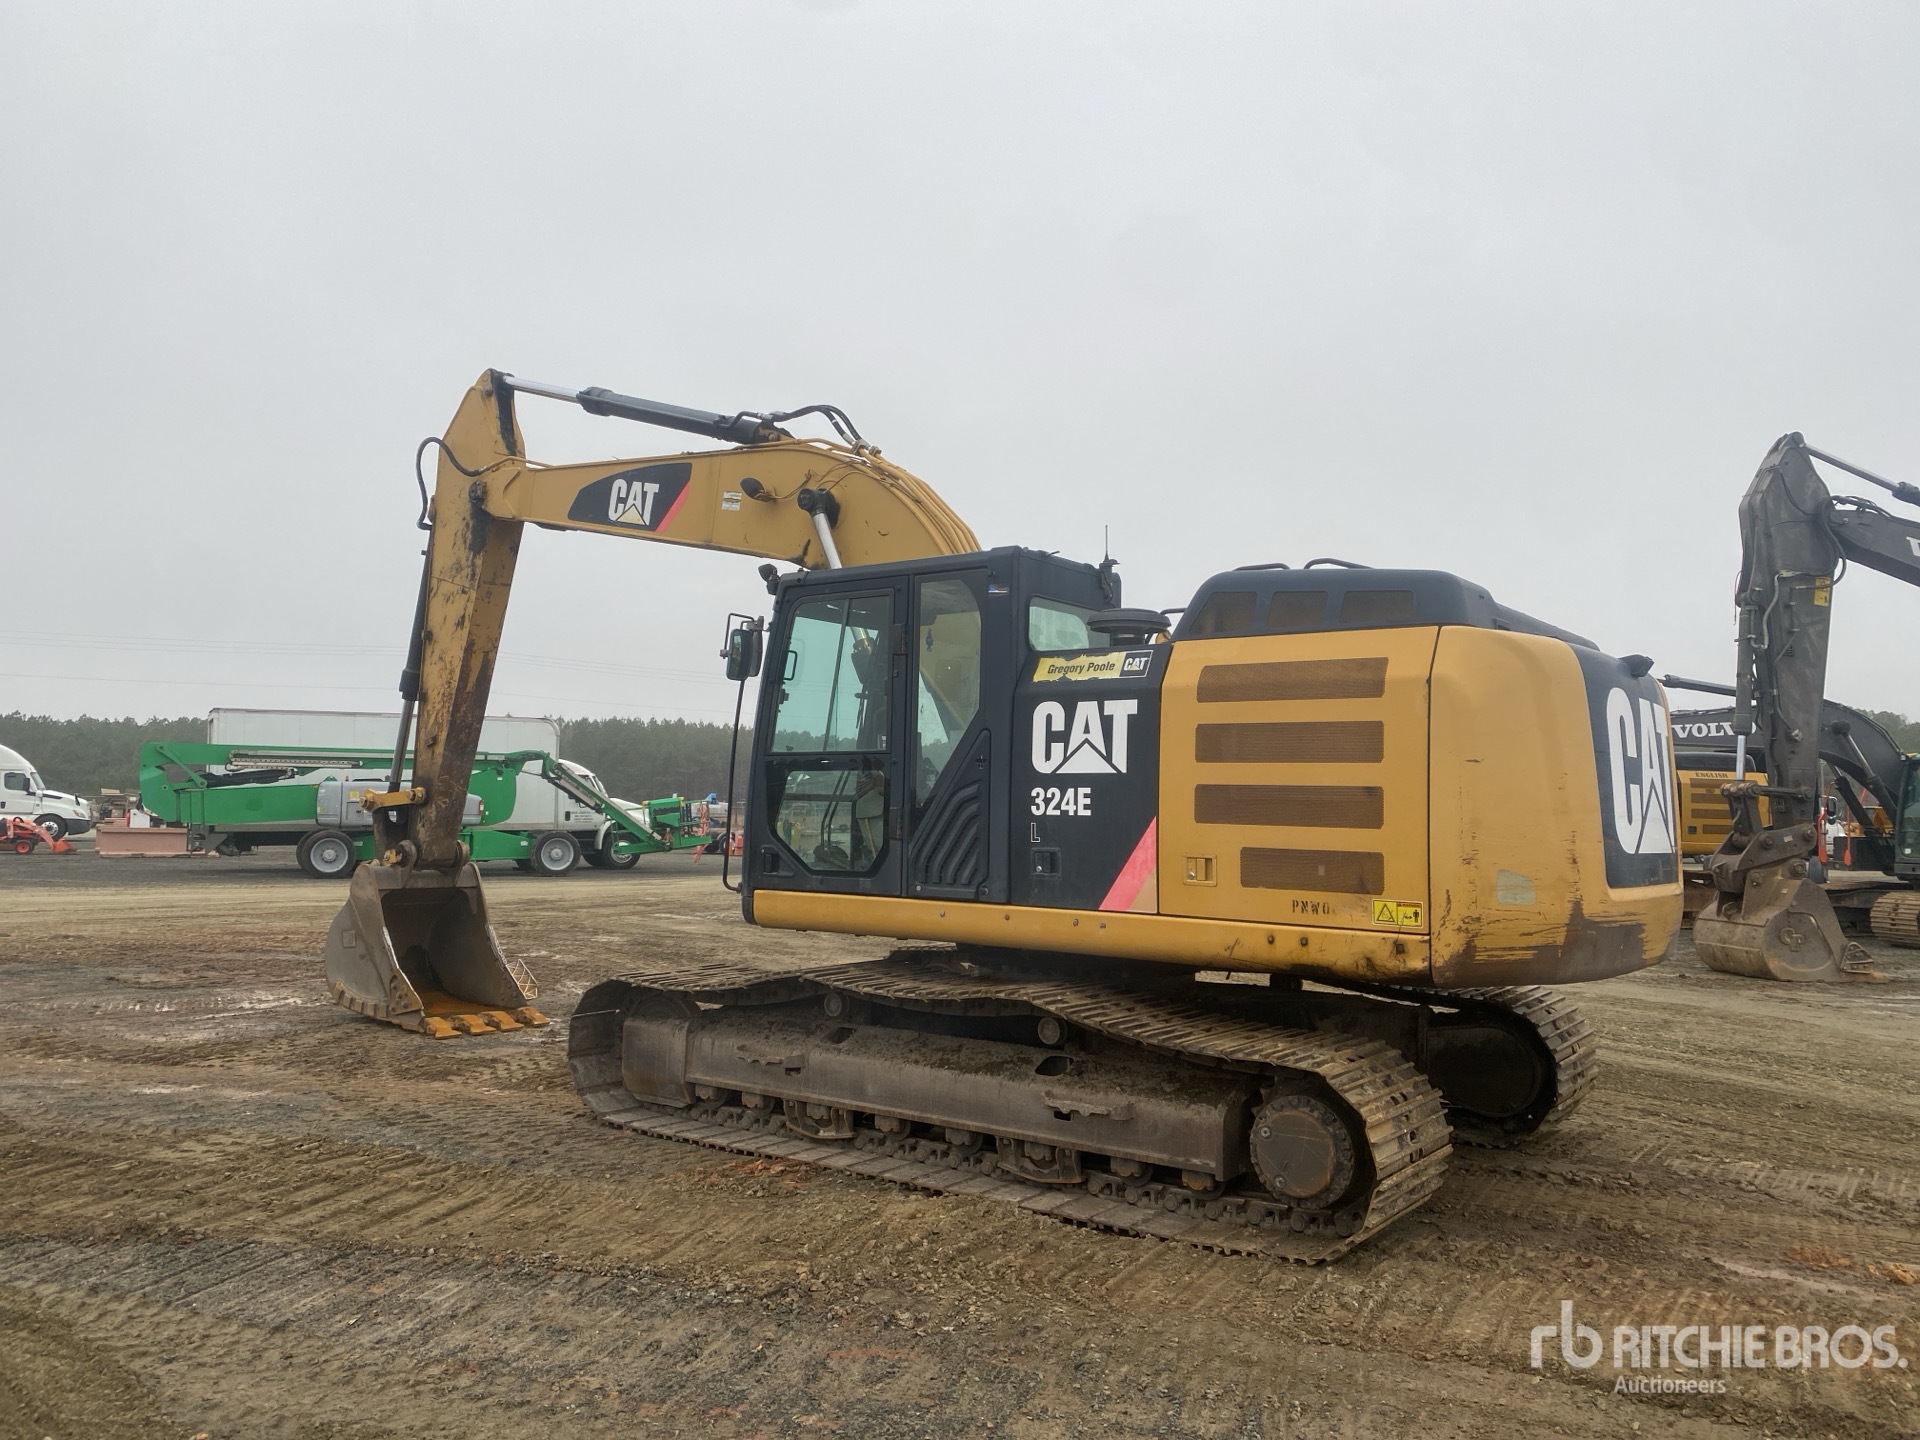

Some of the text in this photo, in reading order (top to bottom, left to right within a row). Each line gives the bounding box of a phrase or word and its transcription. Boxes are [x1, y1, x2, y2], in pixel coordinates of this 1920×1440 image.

[608, 478, 660, 526] CAT
[1047, 657, 1148, 677] Gregory Poole CAT
[1031, 699, 1138, 774] CAT
[1670, 721, 1757, 739] VOLV
[1607, 687, 1675, 854] CAT
[1695, 771, 1729, 779] ENGLISH
[1030, 787, 1092, 816] 324E
[1030, 822, 1041, 843] L
